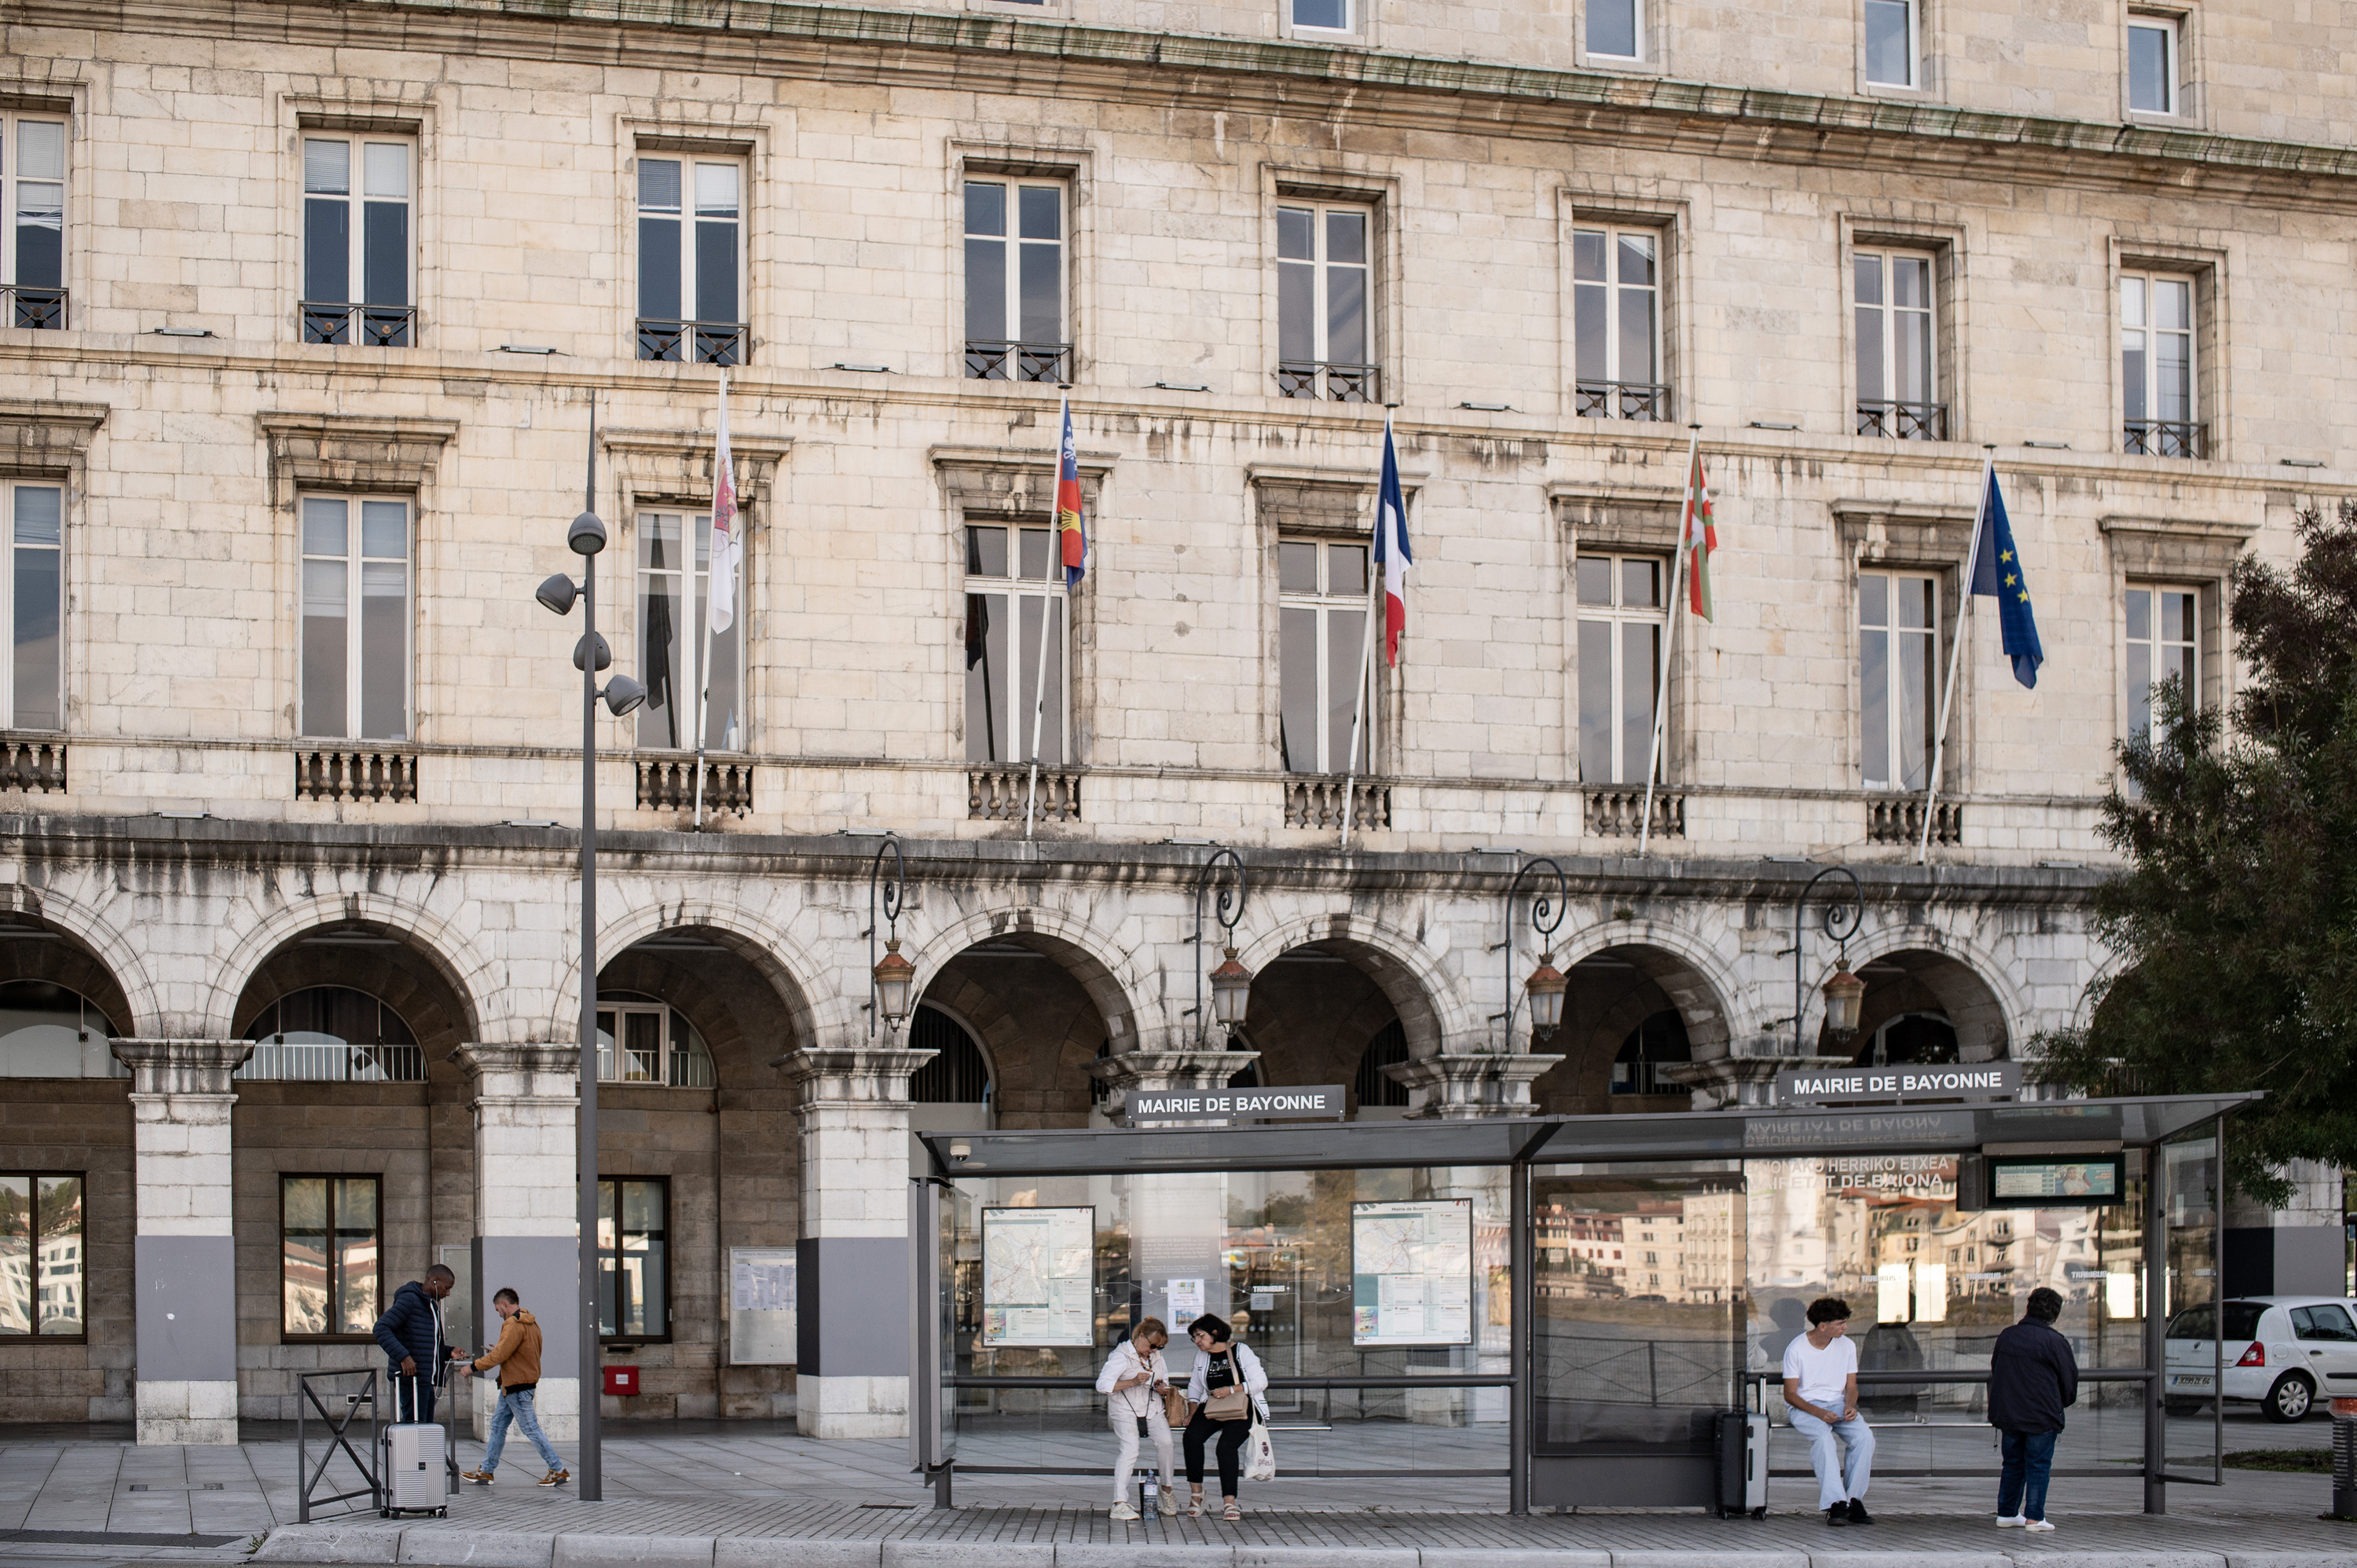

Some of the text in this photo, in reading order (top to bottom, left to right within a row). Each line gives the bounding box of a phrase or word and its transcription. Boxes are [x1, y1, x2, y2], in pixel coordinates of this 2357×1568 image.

[1794, 1072, 2002, 1094] MAIRIE DE BAYONNE
[1138, 1094, 1325, 1113] MAIRIE DE BAYONNE
[1745, 1156, 1949, 1174] BAIONAKO HERRIKO ETXEA
[1747, 1173, 1944, 1191] MAIRETAT DE BAIONA
